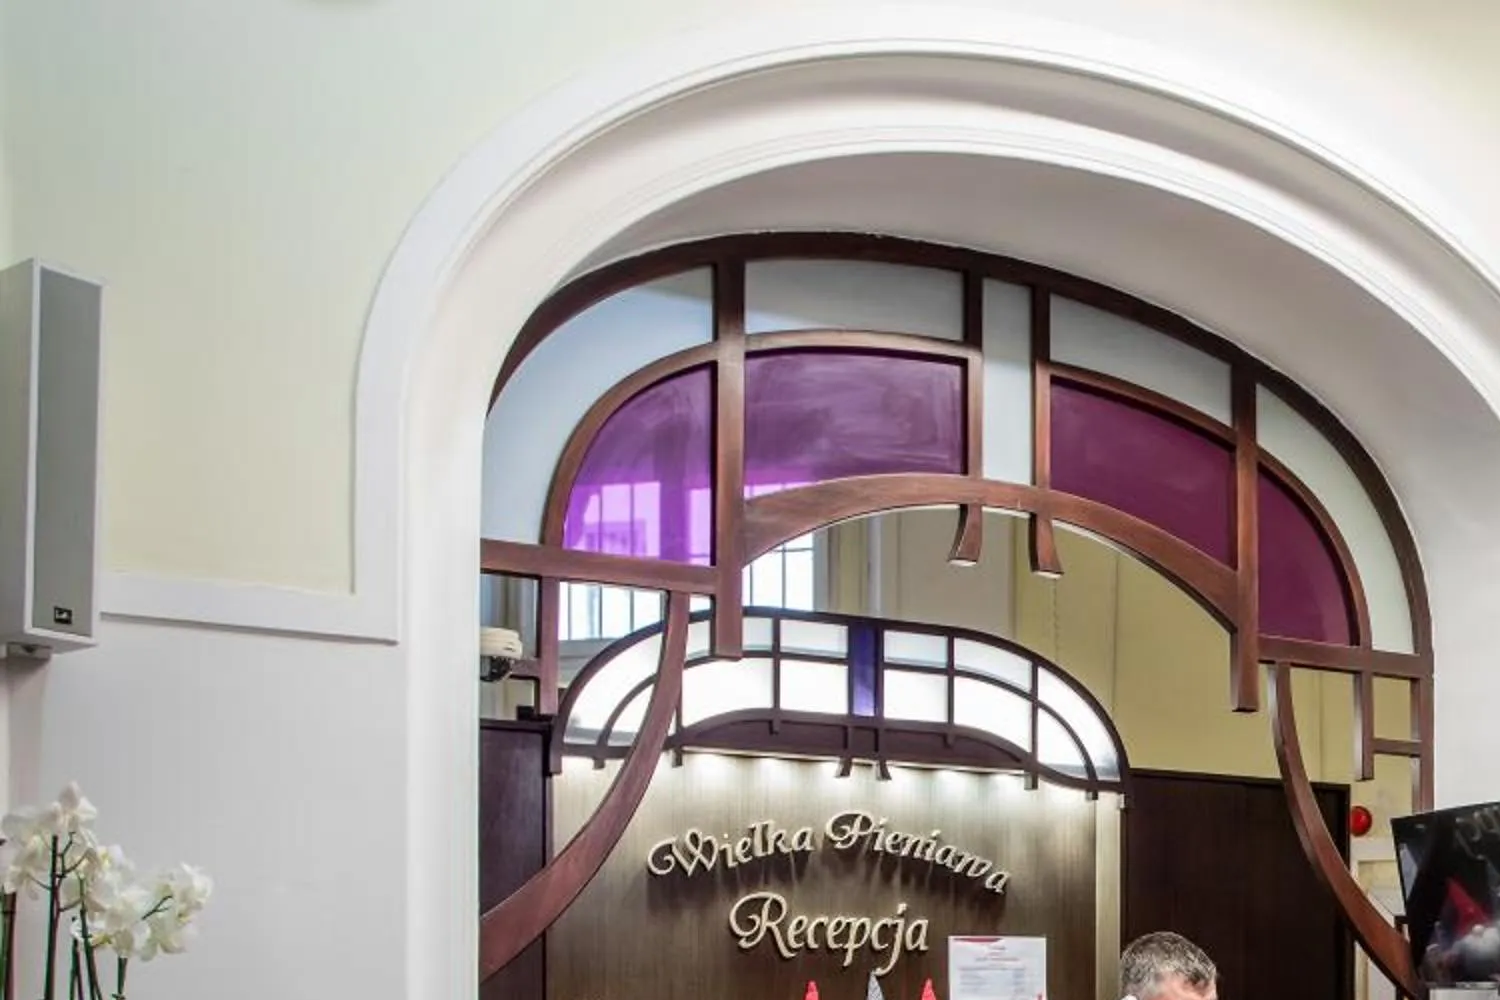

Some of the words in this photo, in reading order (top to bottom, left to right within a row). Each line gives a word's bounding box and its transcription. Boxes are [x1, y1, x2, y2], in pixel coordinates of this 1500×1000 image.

[647, 820, 815, 878] Wielka
[825, 809, 1012, 894] Pieniawa
[729, 891, 930, 976] Recepcja
